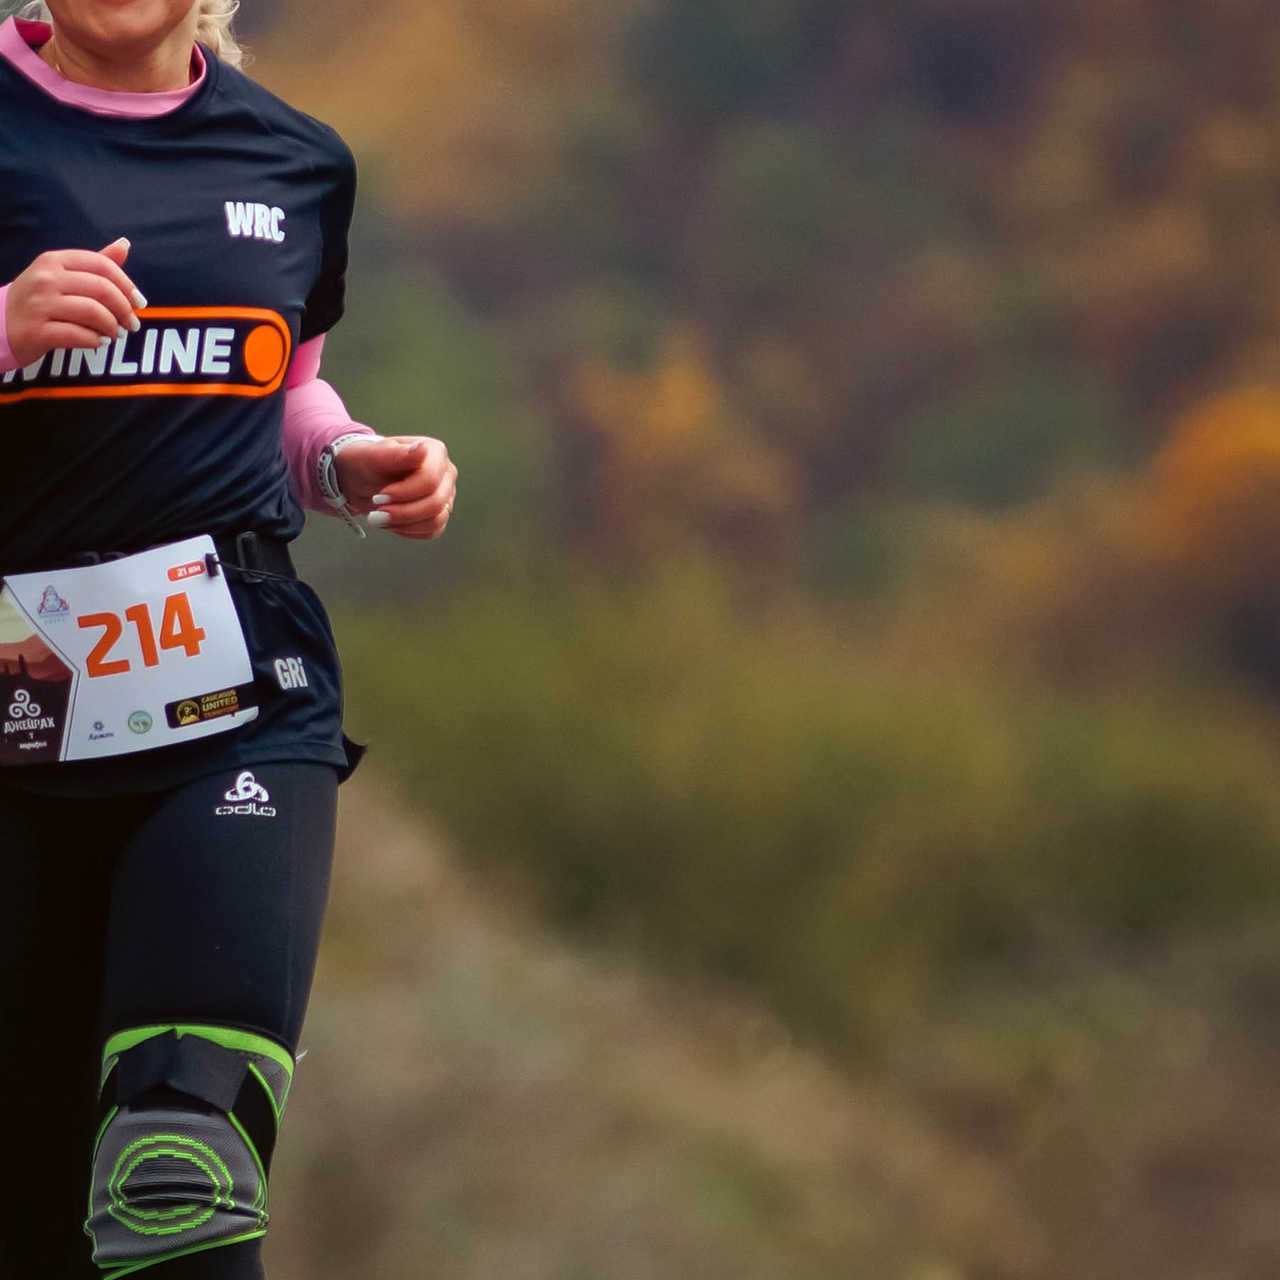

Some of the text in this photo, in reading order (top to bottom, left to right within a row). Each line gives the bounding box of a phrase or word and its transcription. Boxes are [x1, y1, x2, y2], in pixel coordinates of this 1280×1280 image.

[224, 201, 286, 242] WRC
[2, 328, 236, 384] INLINE
[77, 592, 206, 678] 214
[202, 696, 238, 712] UNITED
[215, 803, 277, 817] odlo
